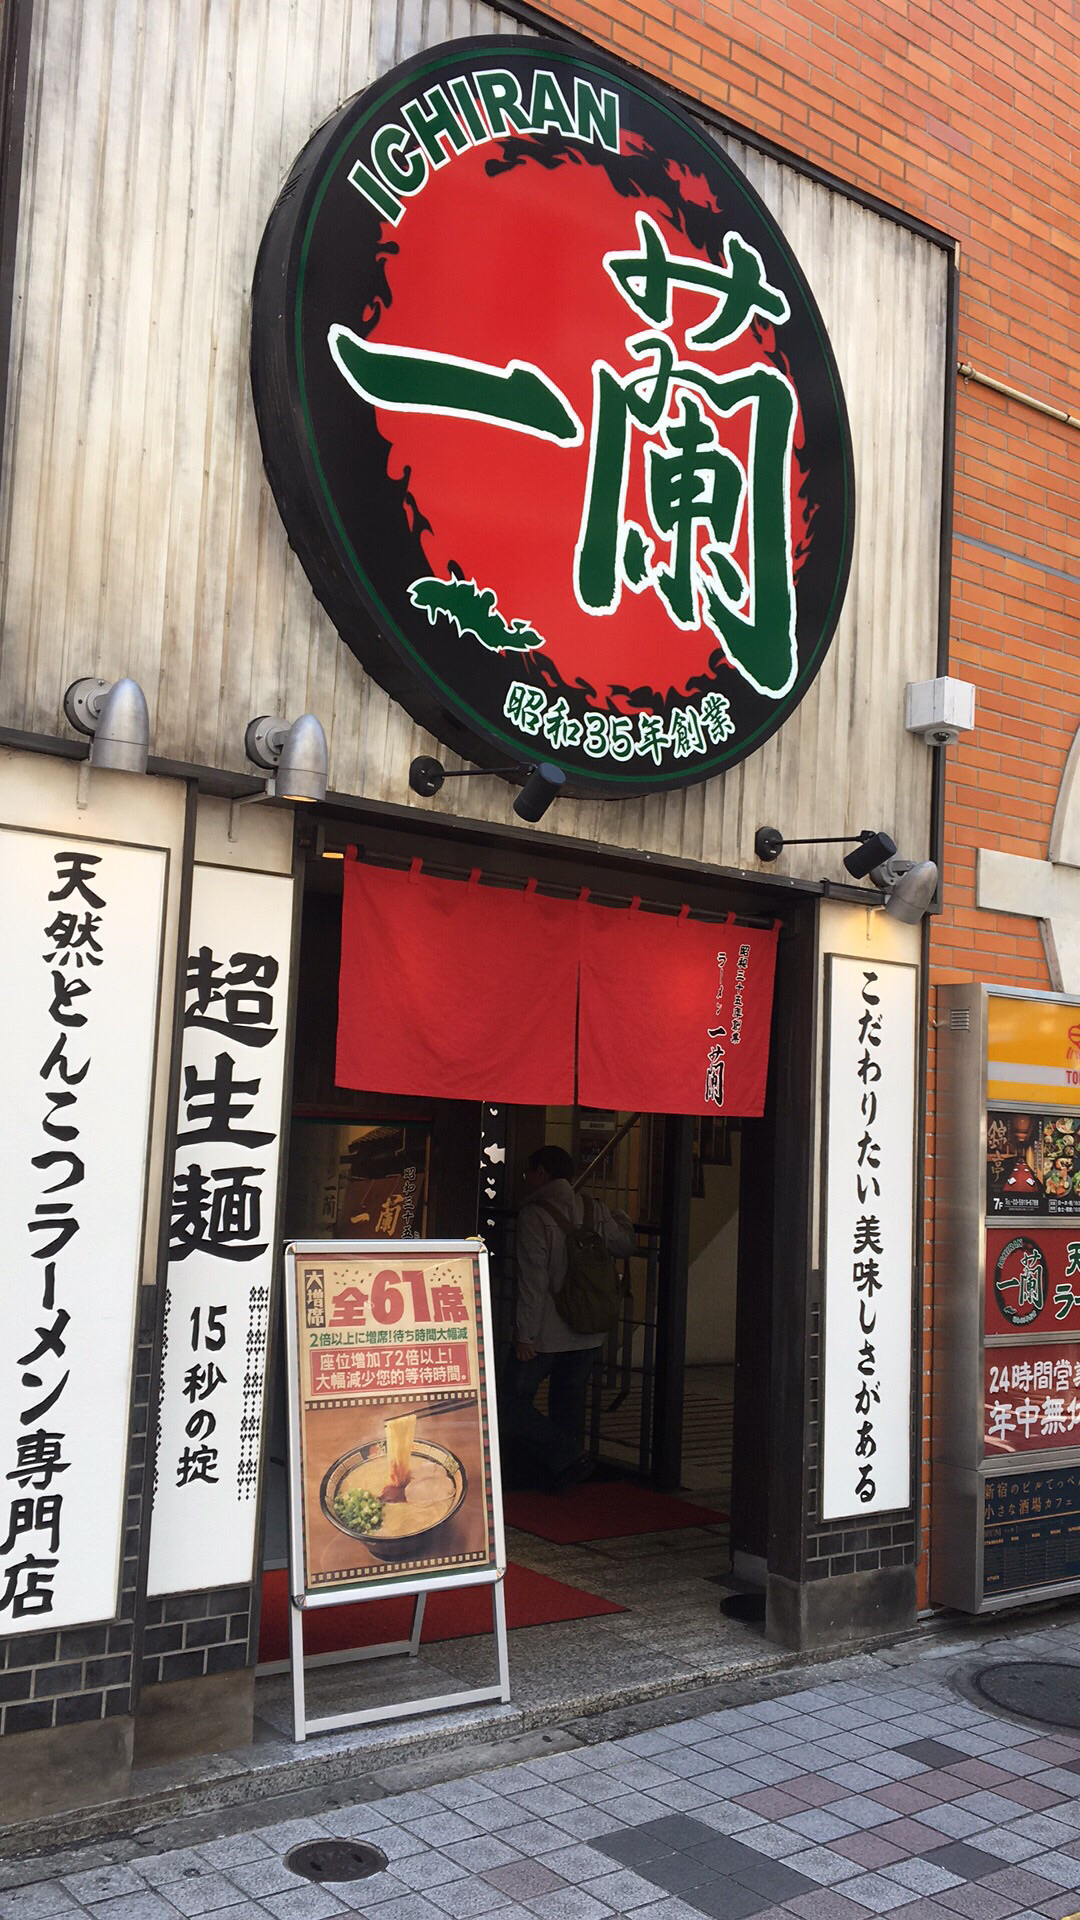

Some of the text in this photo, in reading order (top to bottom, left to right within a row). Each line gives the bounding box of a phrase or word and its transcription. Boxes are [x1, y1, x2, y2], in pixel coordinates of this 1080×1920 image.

[347, 69, 621, 227] ICHIRAN
[327, 210, 799, 699] 一蘭
[503, 680, 736, 763] 昭和35年創業
[715, 951, 727, 1016] ラーメン
[1065, 1070, 1080, 1086] TO
[0, 851, 107, 1619] 天然とんこつラーメン専門店
[993, 1197, 1004, 1211] 7F
[853, 971, 884, 1503] こだわりたい美味しさがある
[306, 1271, 324, 1326] 大増席
[328, 1269, 470, 1328] 全61席
[996, 1248, 1044, 1310] 一蘭
[176, 1304, 228, 1488] 15秒の掟
[984, 1475, 1080, 1500] 新宿のビルてっぺ
